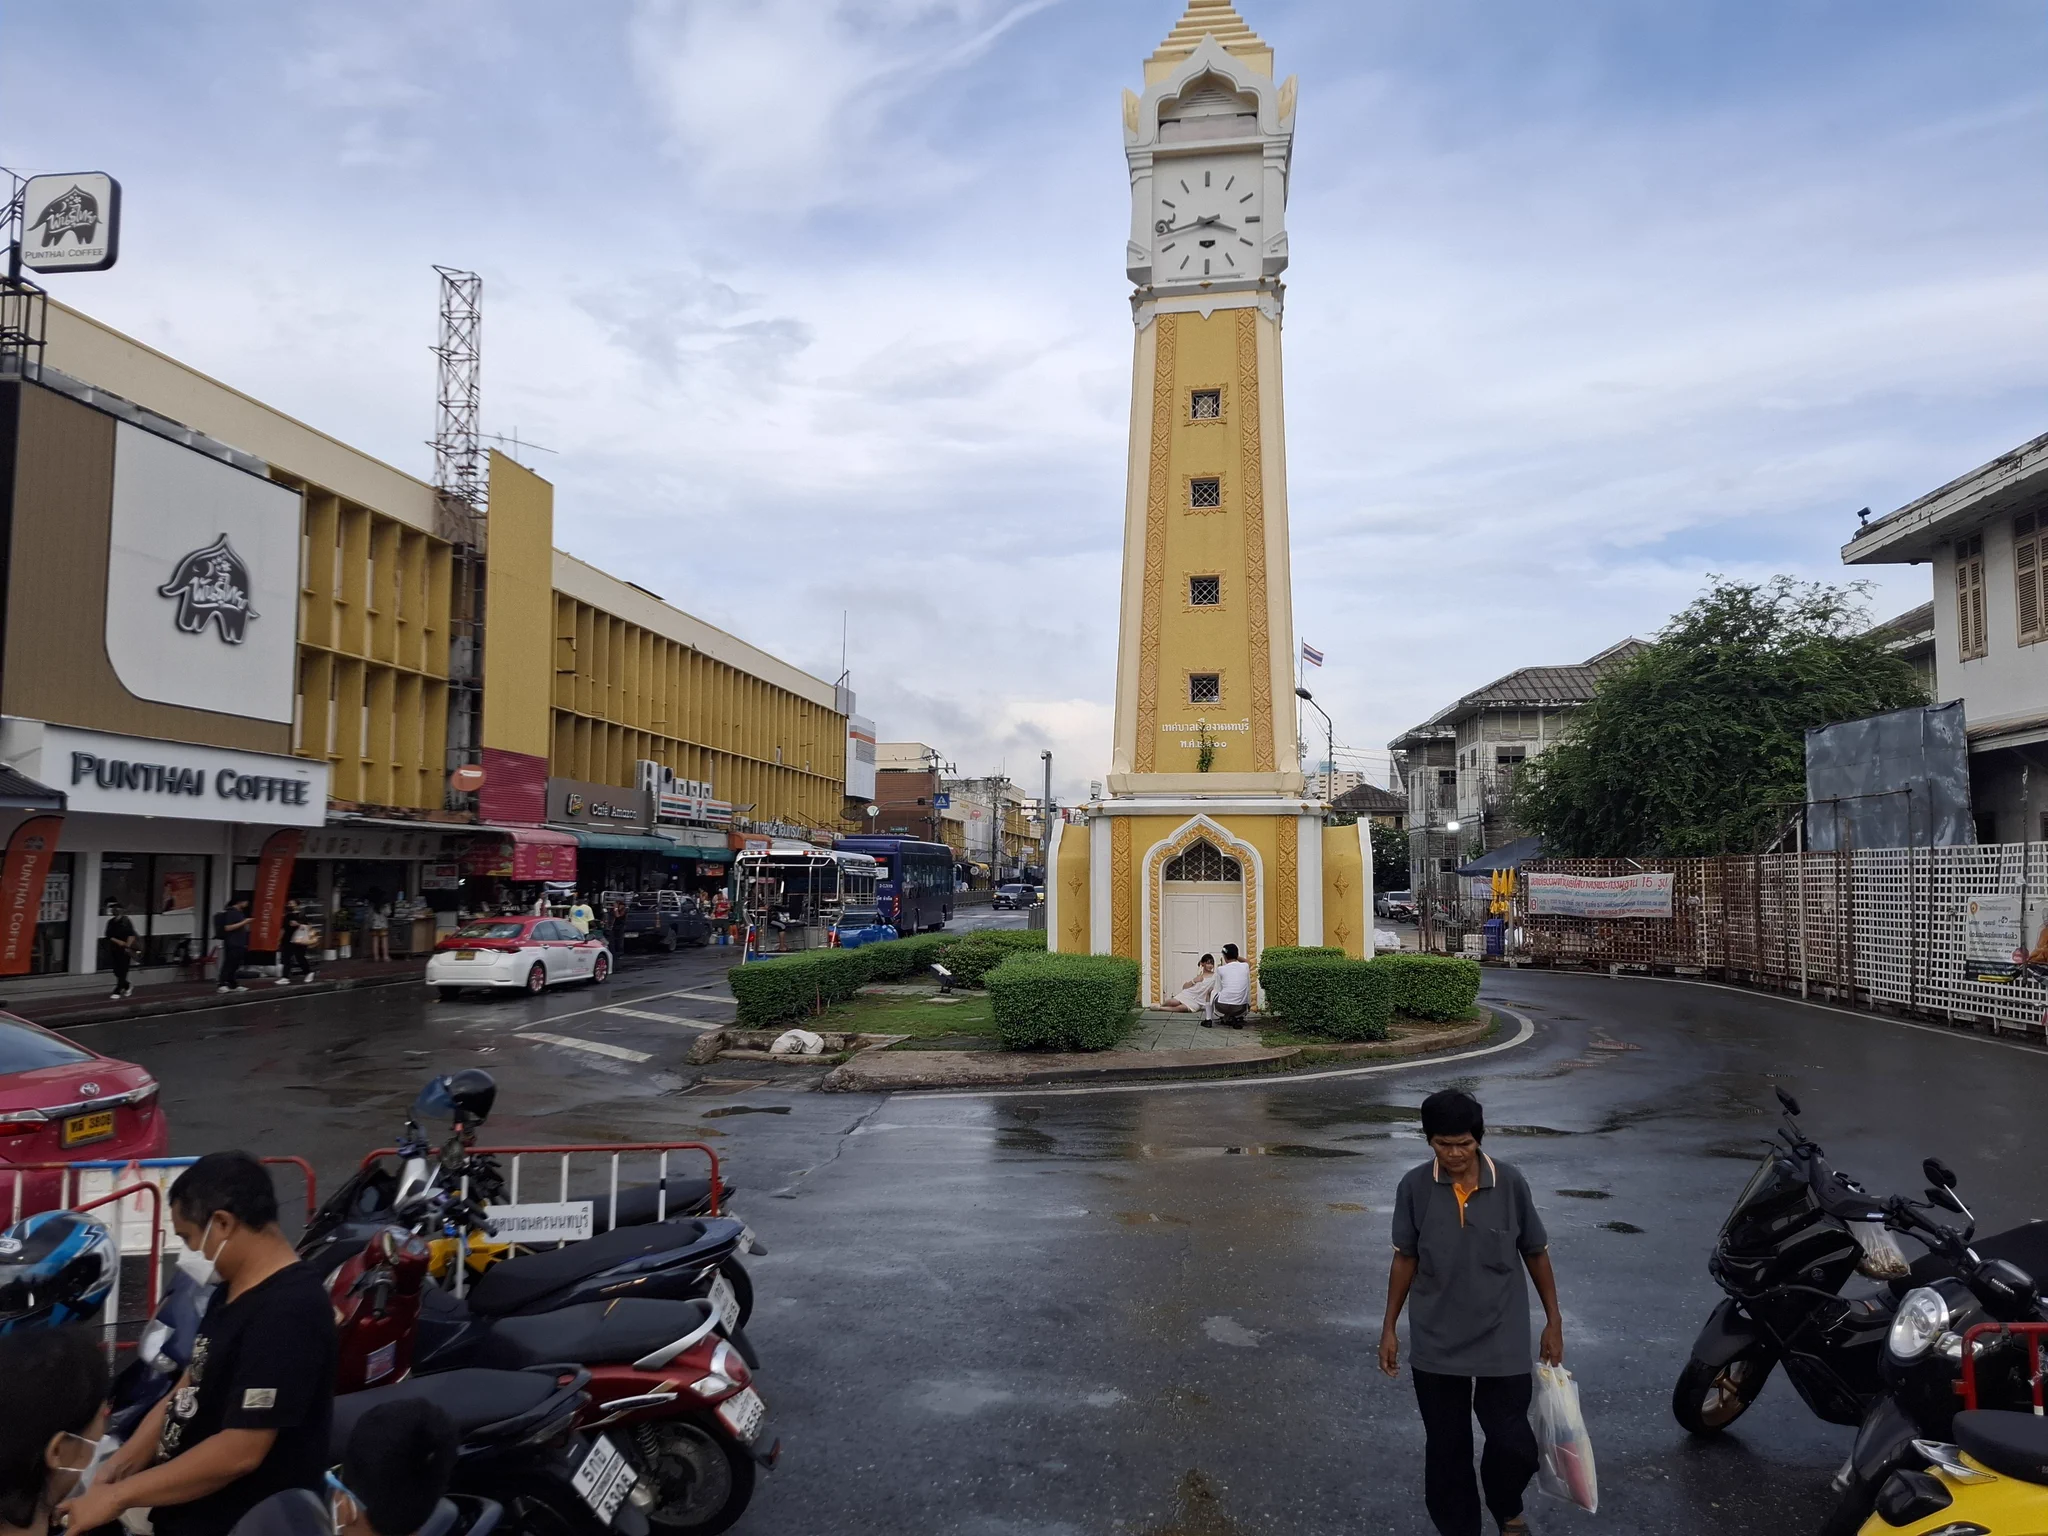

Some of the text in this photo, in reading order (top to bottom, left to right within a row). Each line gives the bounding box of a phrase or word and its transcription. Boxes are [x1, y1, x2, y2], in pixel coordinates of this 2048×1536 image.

[24, 247, 104, 260] PUNTHAI COFFEE
[70, 750, 311, 806] PUNTHAI COFFEE
[591, 801, 638, 819] Café Amazon
[1641, 876, 1653, 888] 15
[4, 854, 37, 960] PUNTHAI COFFEE
[489, 1206, 589, 1235] ทศบาลนครนนทบุรี
[1991, 1277, 2015, 1295] HONDA
